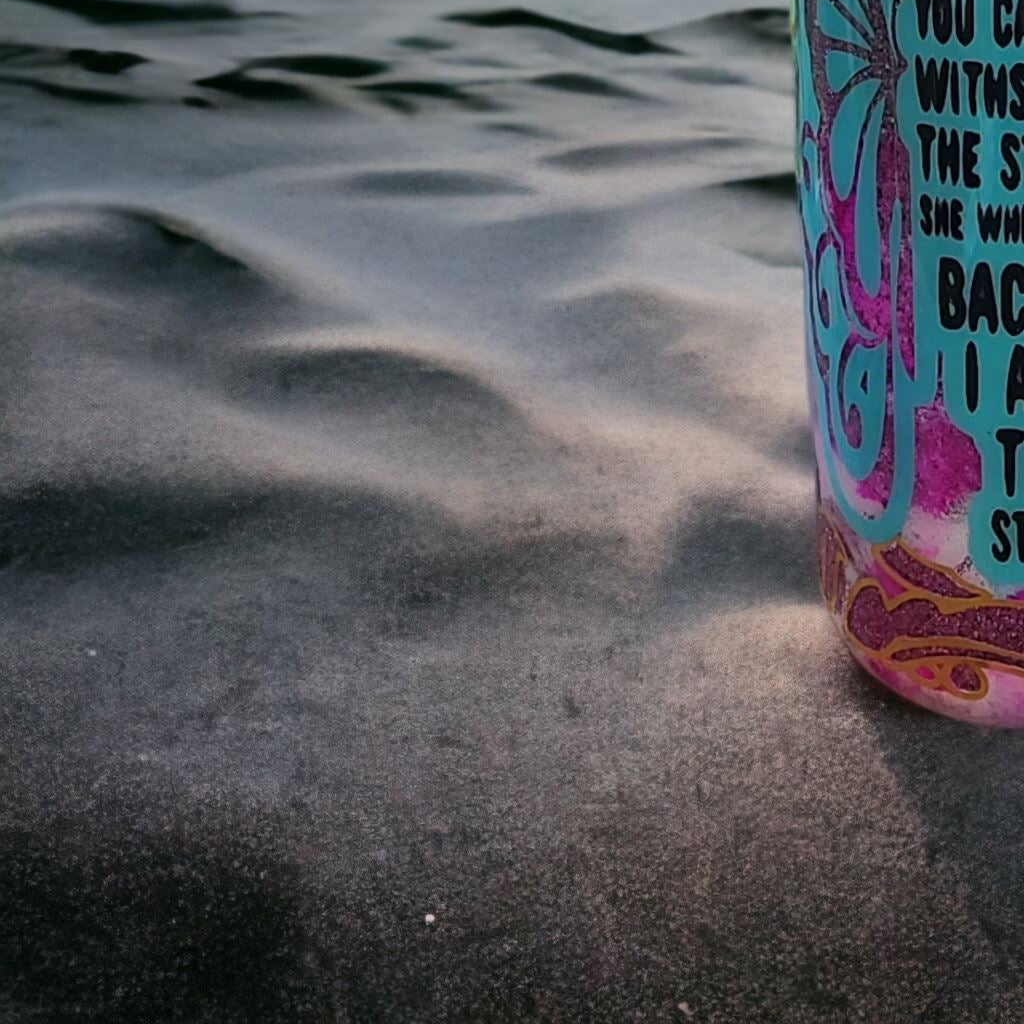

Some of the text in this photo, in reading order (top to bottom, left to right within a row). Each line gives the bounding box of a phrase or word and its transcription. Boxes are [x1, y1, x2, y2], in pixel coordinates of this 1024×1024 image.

[915, 123, 982, 190] THE
[919, 193, 965, 242] SHE
[965, 340, 979, 414] I
